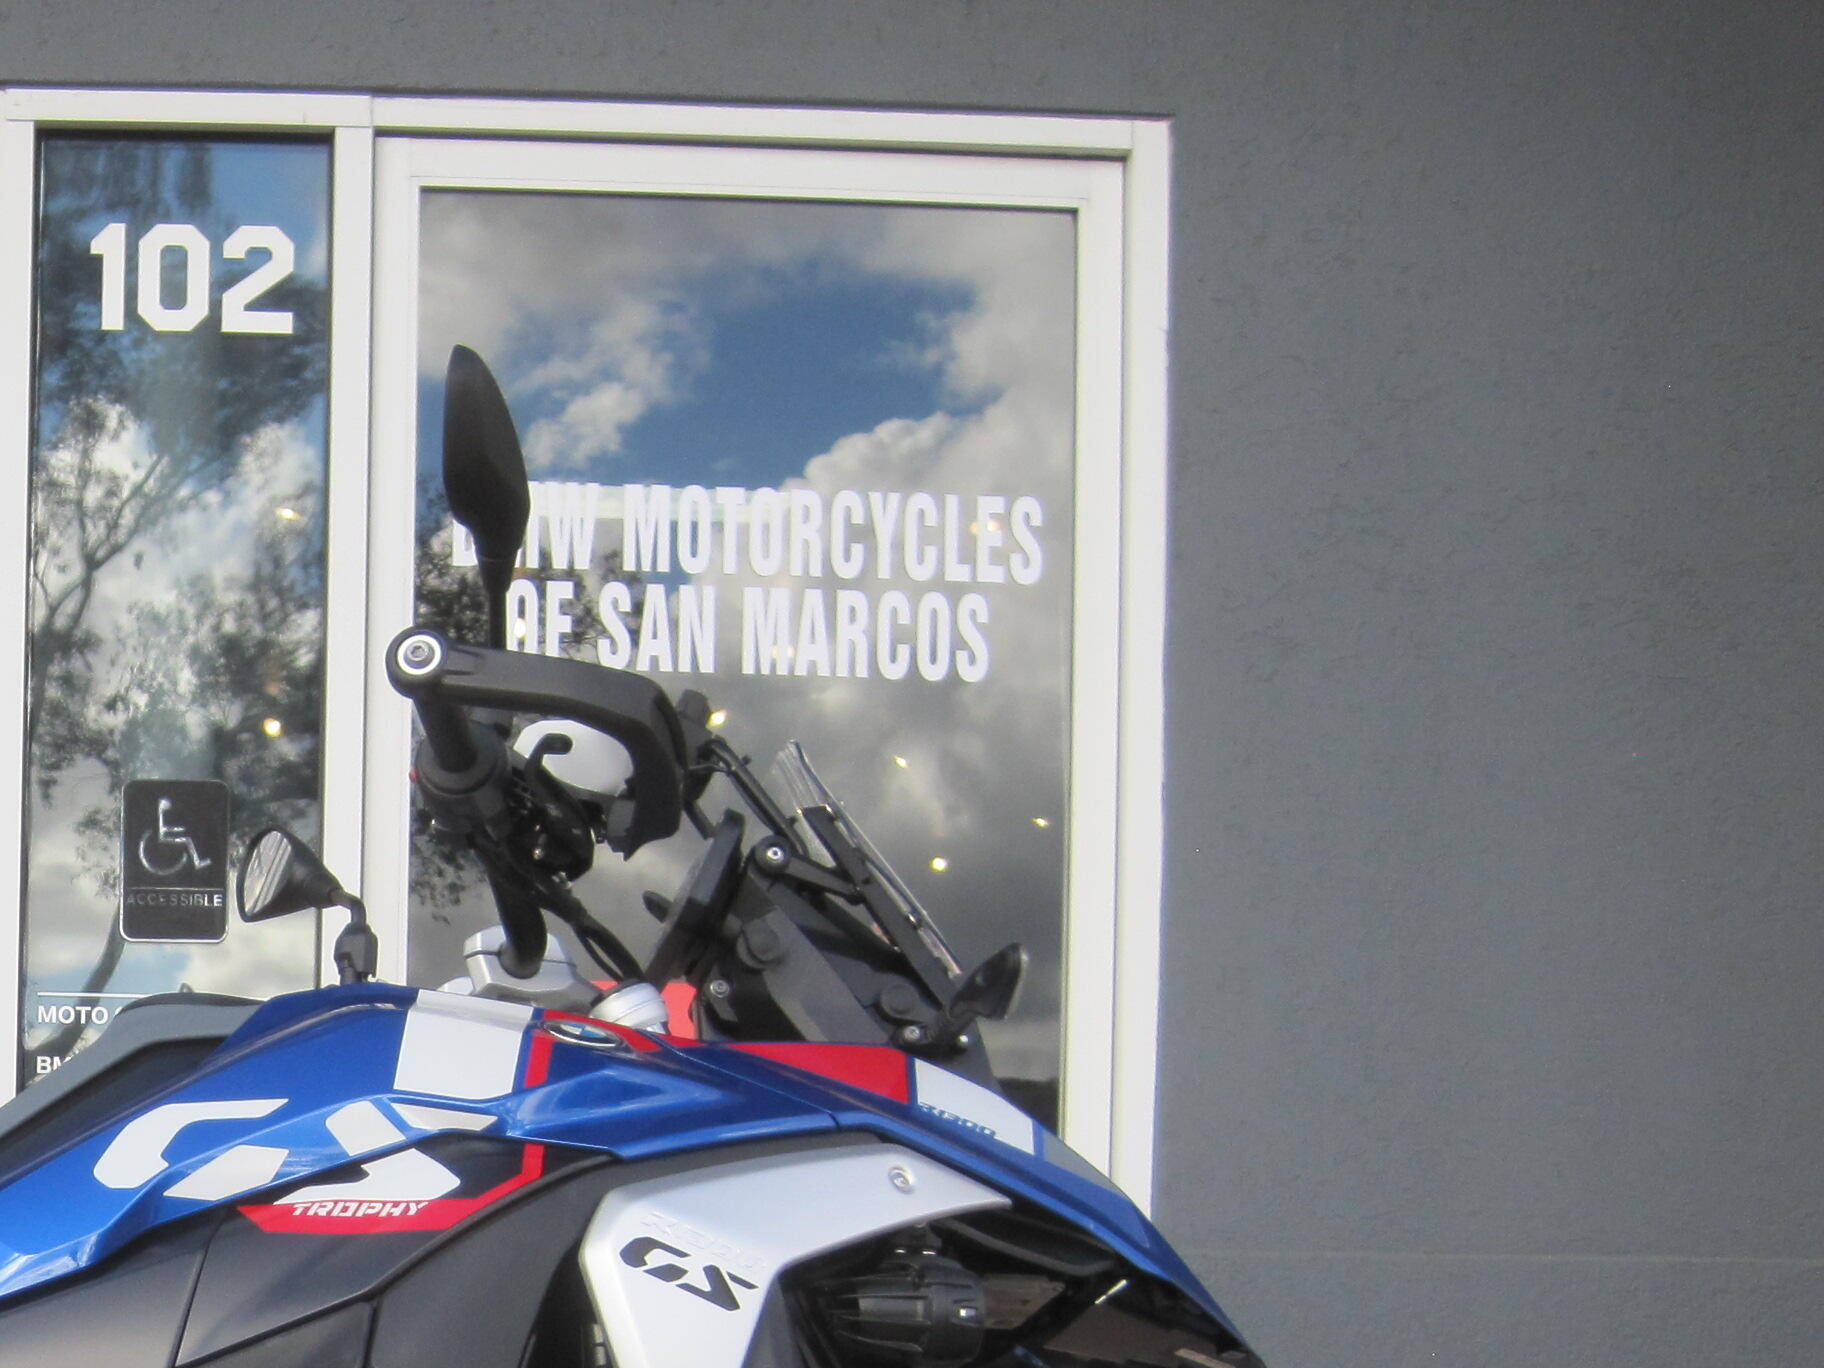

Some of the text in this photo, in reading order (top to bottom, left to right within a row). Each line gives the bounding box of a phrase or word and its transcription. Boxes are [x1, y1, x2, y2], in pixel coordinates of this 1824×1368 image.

[90, 223, 294, 333] 102
[622, 483, 1044, 585] MOTORCYCLES
[506, 579, 990, 682] OF SAN MARCOS
[126, 893, 223, 907] ACCESSIBLE
[37, 1005, 109, 1025] MOTO
[292, 1201, 428, 1218] TROPHY
